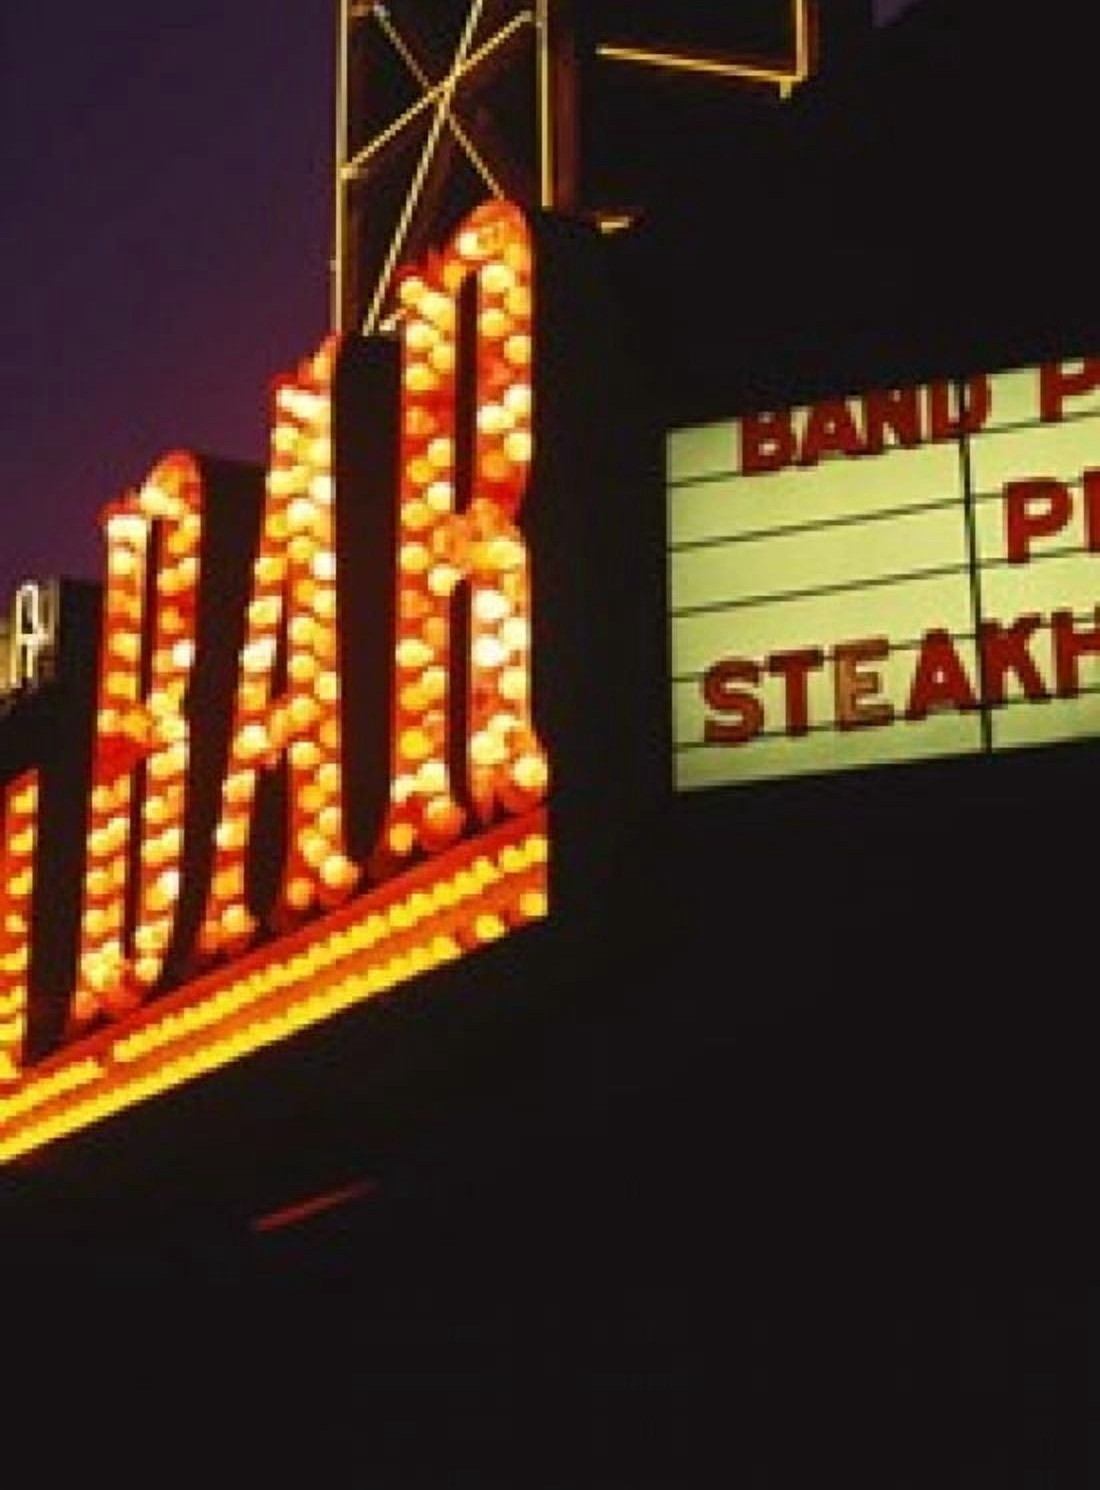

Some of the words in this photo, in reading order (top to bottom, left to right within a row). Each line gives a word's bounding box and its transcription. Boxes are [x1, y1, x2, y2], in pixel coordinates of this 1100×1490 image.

[738, 374, 993, 476] BAND
[72, 202, 548, 1025] BAR
[702, 606, 1100, 746] STEAKH
